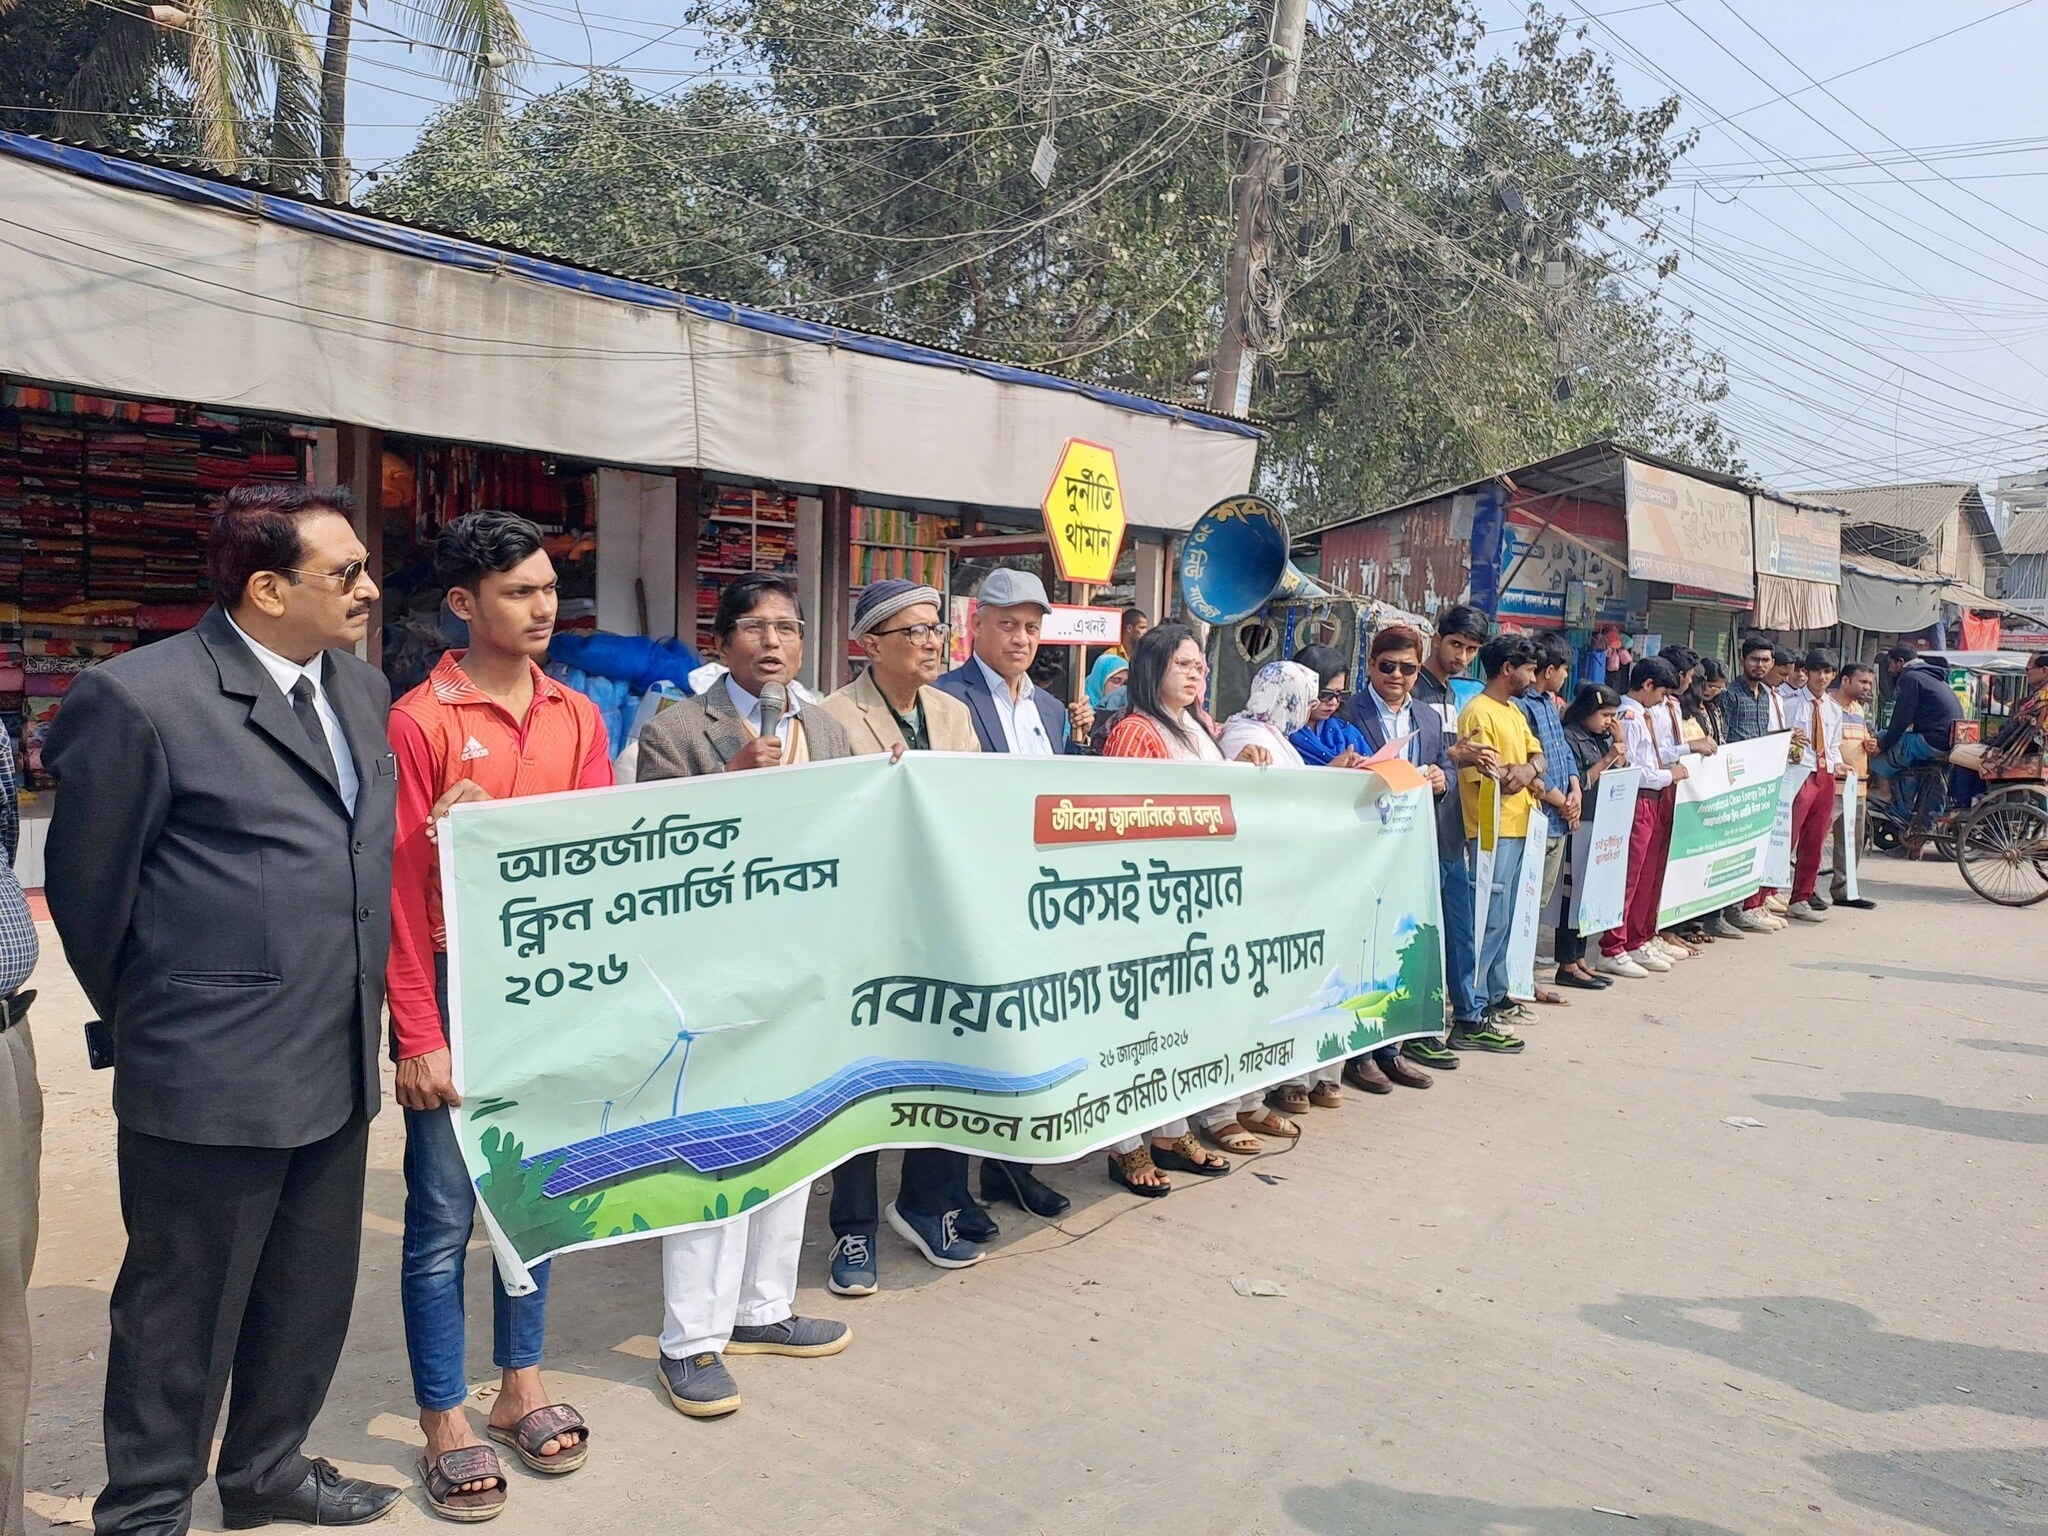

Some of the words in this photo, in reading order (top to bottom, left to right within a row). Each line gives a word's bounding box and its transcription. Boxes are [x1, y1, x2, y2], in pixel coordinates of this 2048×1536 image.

[1065, 468, 1115, 516] দুর্নীতি
[1065, 520, 1112, 558] থামান
[460, 747, 490, 762] adidas
[1052, 798, 1107, 832] জীবাশ্ম
[1108, 799, 1177, 836] জ্বালানিকে
[1176, 806, 1193, 826] না
[1192, 805, 1223, 834] বলুন
[497, 814, 741, 883] আন্তর্জাতিক
[499, 896, 594, 958] ক্লিন
[605, 860, 733, 925] এনার্জি
[743, 856, 839, 902] দিবস
[1028, 861, 1140, 931] টেকসই
[1148, 858, 1243, 925] উন্নয়নে
[505, 953, 628, 1006] ২০২৬
[851, 966, 1101, 1037] নবায়নযোগ্য
[1108, 932, 1213, 1021] জ্বালানি
[1221, 944, 1240, 986] ও
[1247, 929, 1325, 998] সুশাসন
[1100, 1049, 1115, 1068] ২৬
[1117, 1031, 1158, 1066] জানুয়ারি
[1160, 1029, 1189, 1050] ২০২৬
[890, 1103, 1023, 1142] সচেতন
[1030, 1092, 1110, 1143] নাগরিক
[1114, 1068, 1167, 1115] কমিটি
[1172, 1054, 1234, 1102] (সনাক),
[1239, 1038, 1295, 1074] গাইবান্ধা
